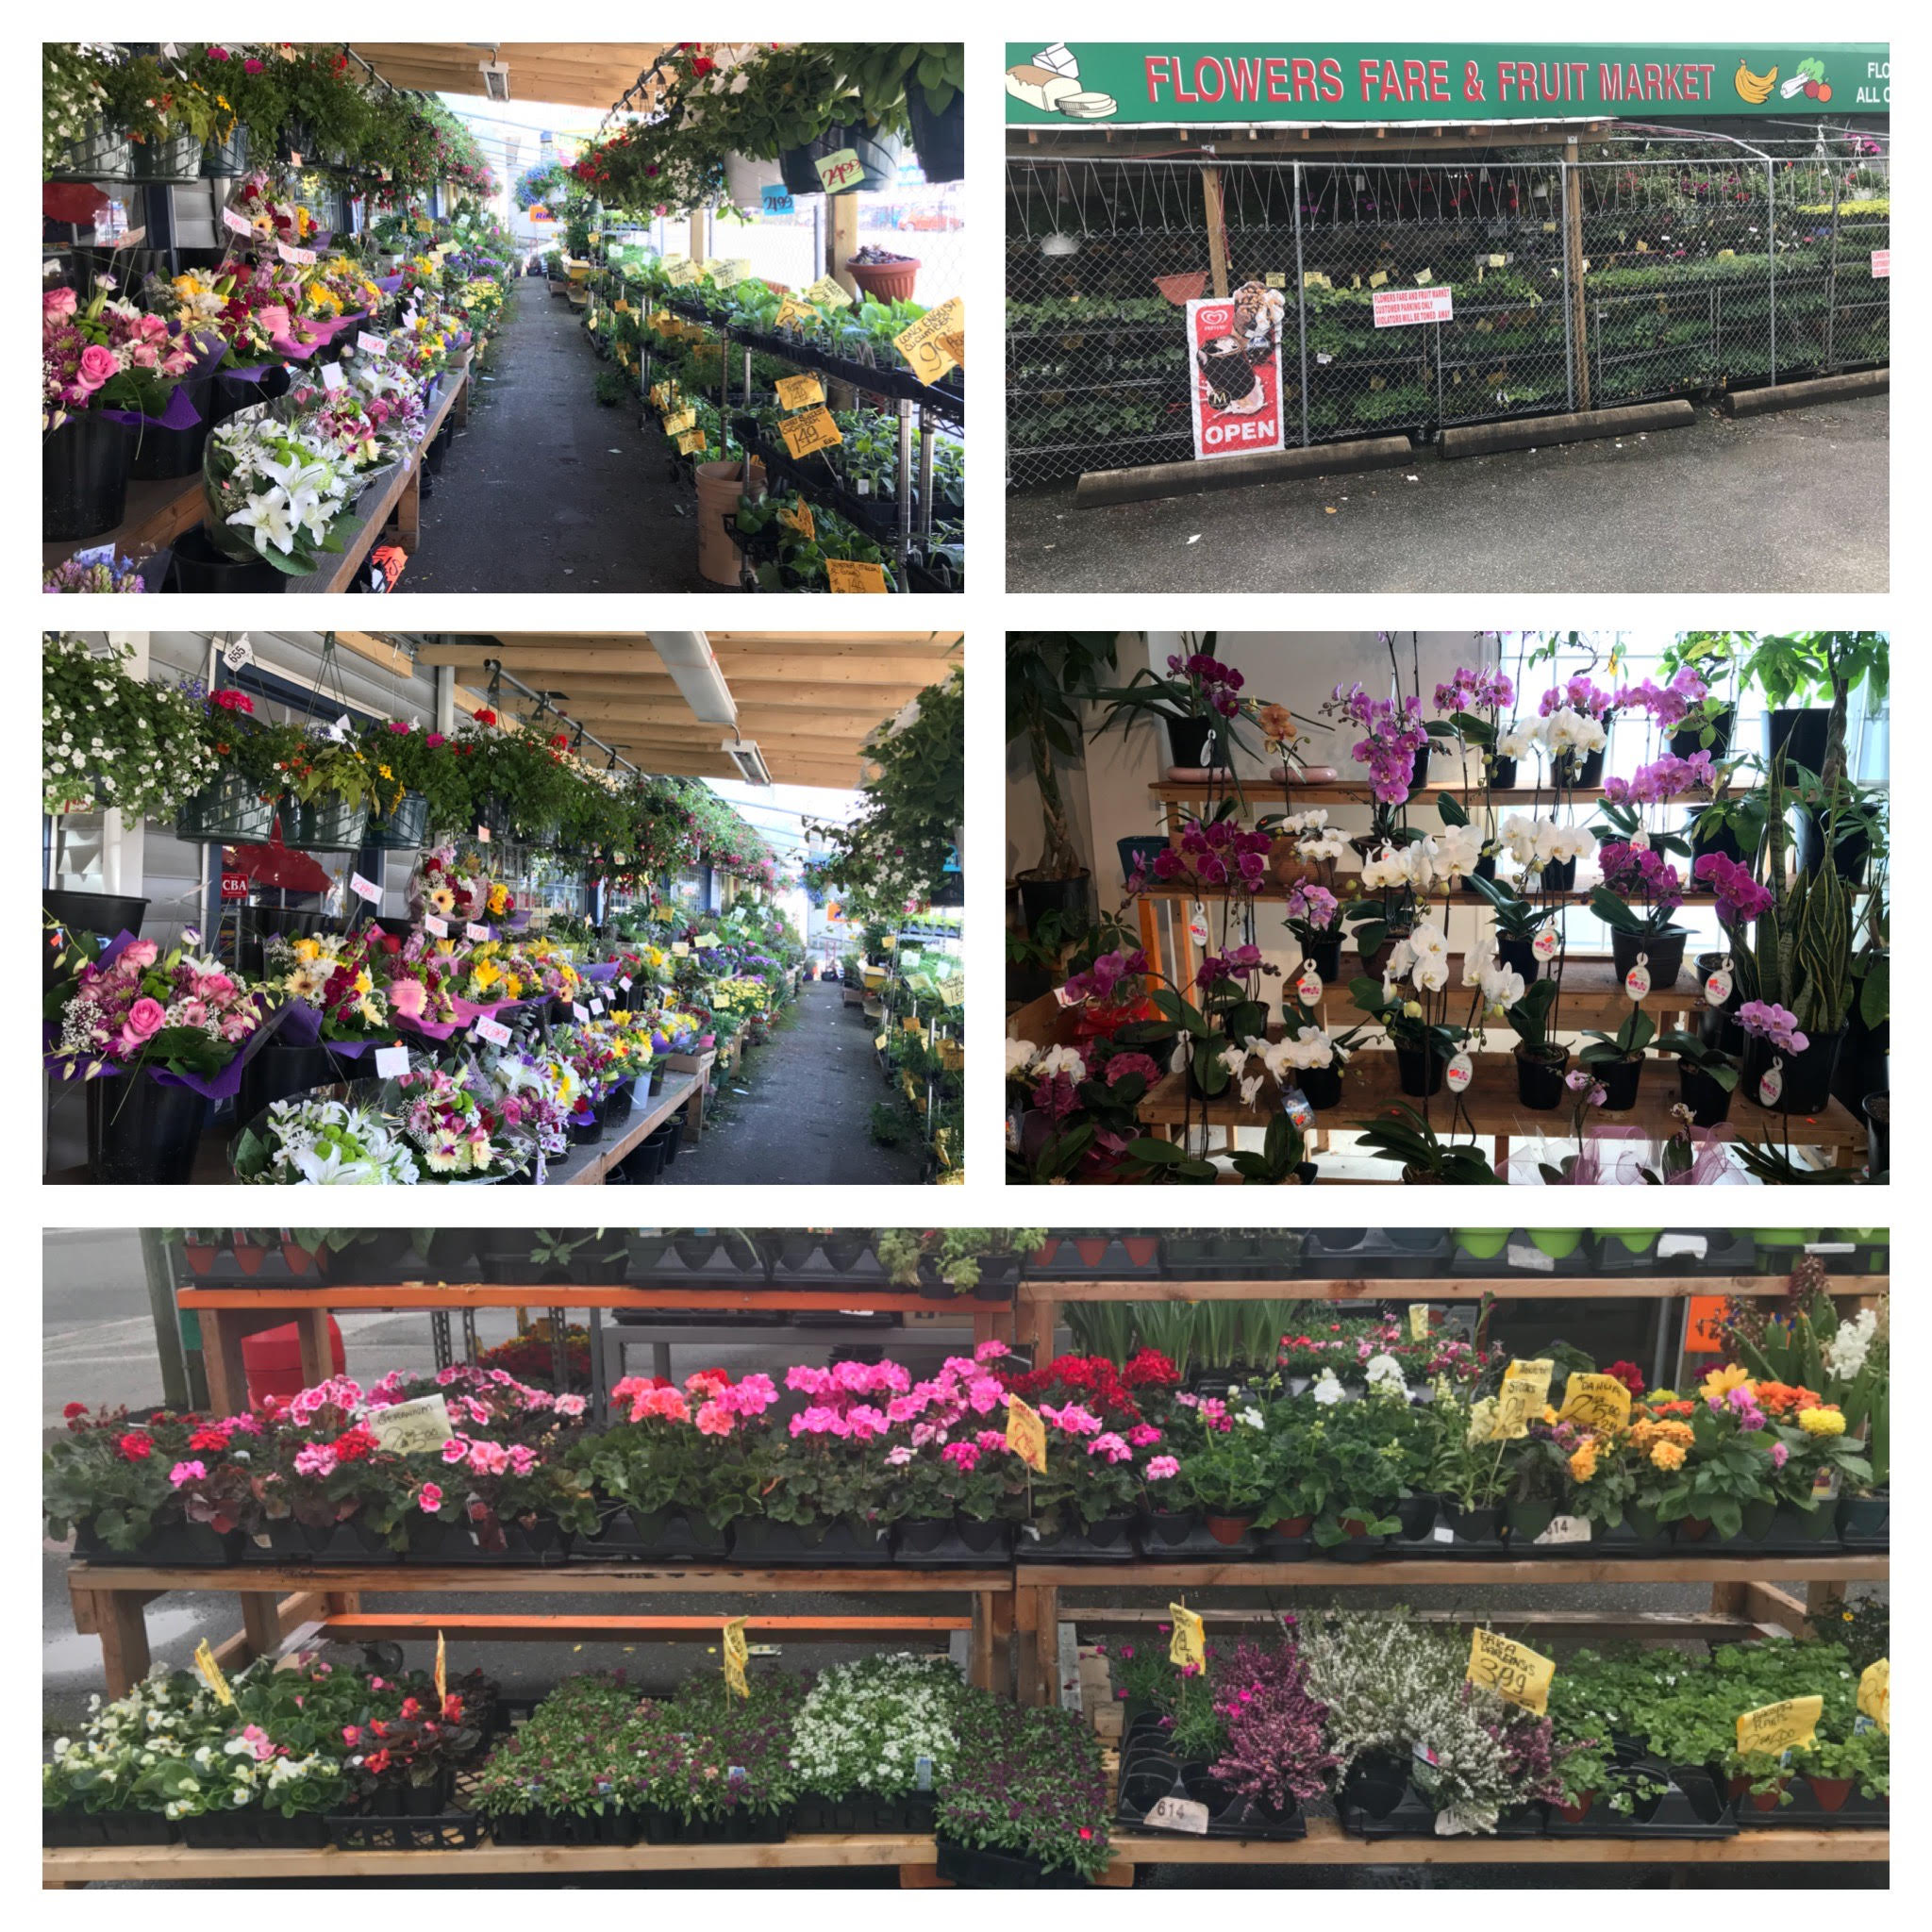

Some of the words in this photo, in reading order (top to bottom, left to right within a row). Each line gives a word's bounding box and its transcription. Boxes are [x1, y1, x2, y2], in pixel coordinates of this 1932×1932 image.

[1144, 56, 1344, 103] FLOWERS
[1358, 59, 1451, 102] FARE
[1463, 60, 1486, 102] &
[1497, 61, 1589, 102] FRUIT
[1599, 63, 1715, 101] MARKET
[1856, 86, 1880, 103] ALL
[1374, 292, 1396, 304] FLOWERS
[1396, 291, 1408, 302] FARE
[1408, 291, 1418, 301] AND
[1418, 290, 1431, 300] FRUIT
[1431, 289, 1450, 298] MARKET
[1375, 304, 1400, 314] CUSTOMER
[1401, 302, 1421, 311] PARKING
[1422, 300, 1433, 310] ONLY
[1375, 314, 1402, 325] VIOLATORS
[1402, 313, 1413, 323] WILL
[1414, 312, 1420, 322] BE
[1420, 311, 1436, 321] TOWED
[1438, 309, 1450, 319] AWAY
[899, 325, 922, 345] LONG
[1205, 420, 1275, 445] OPEN
[227, 645, 246, 663] 655
[223, 879, 247, 891] CBA
[1158, 1800, 1184, 1820] 614
